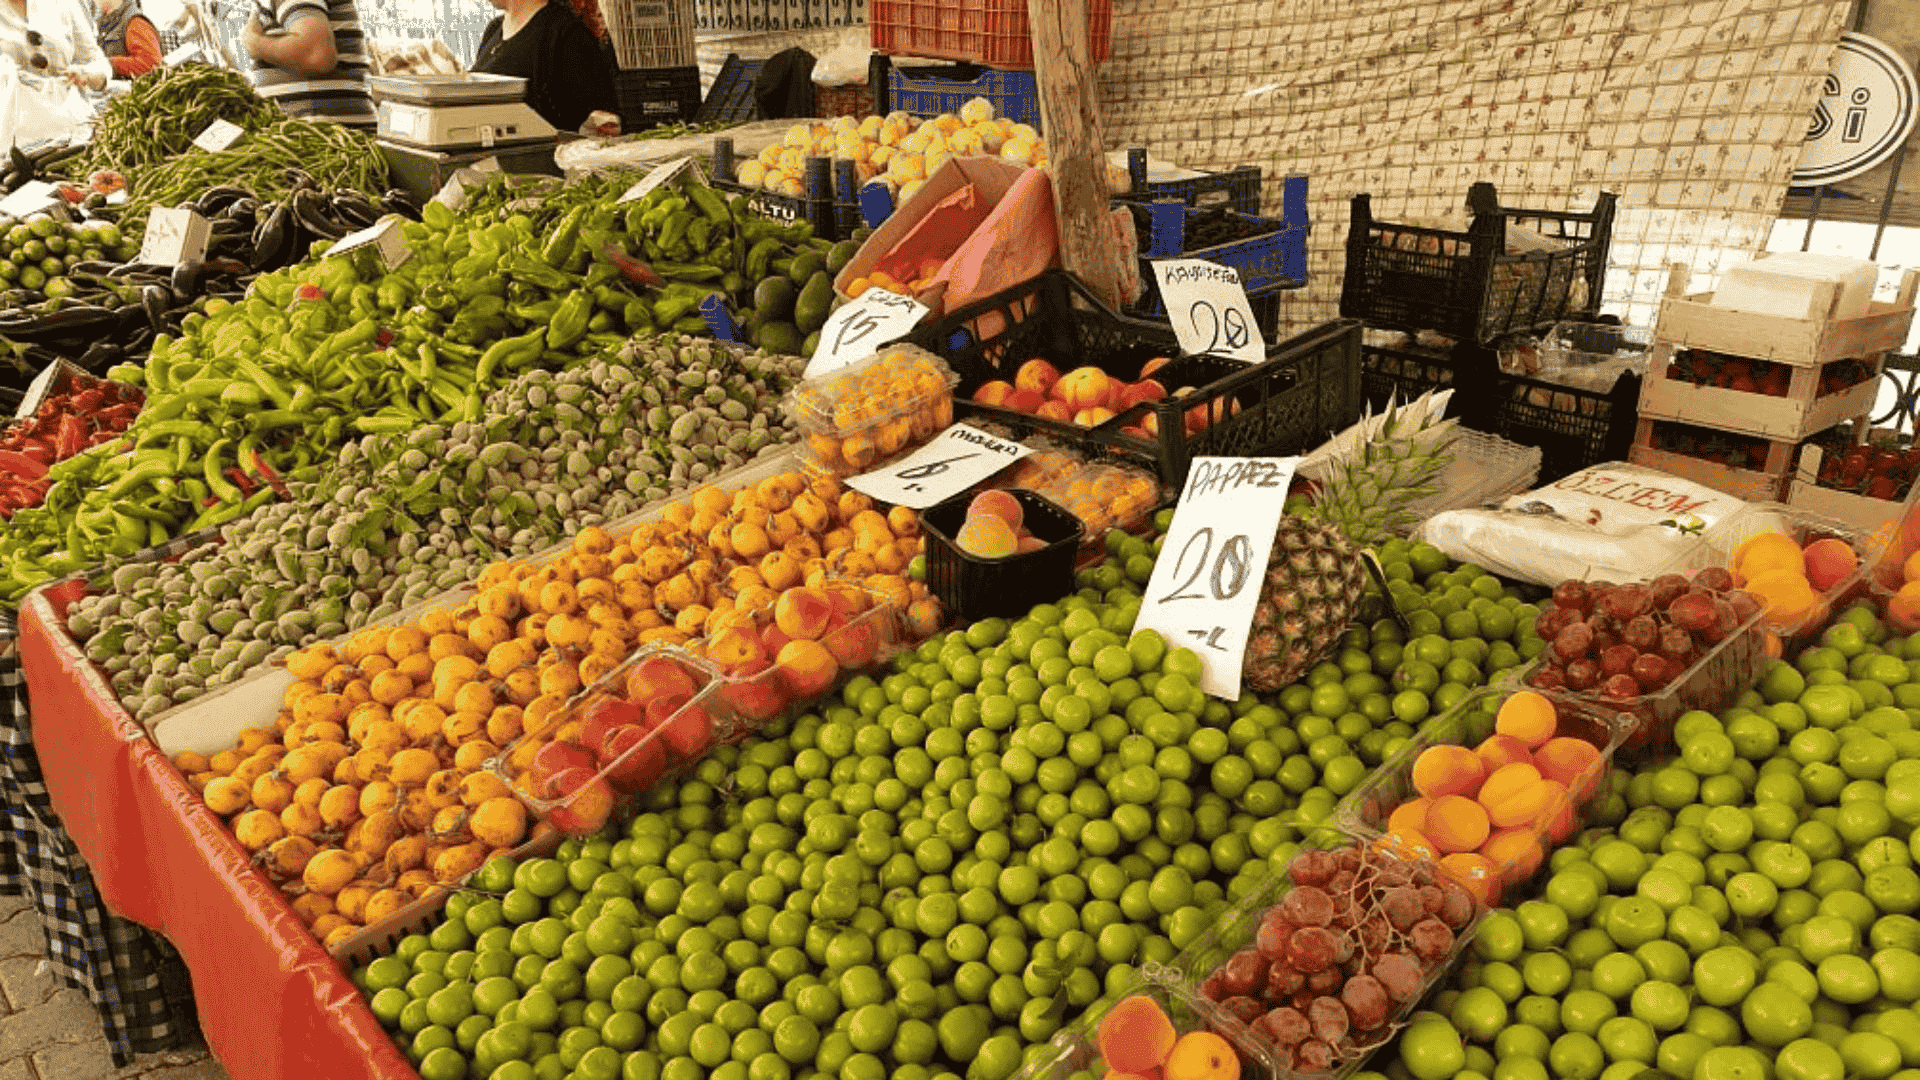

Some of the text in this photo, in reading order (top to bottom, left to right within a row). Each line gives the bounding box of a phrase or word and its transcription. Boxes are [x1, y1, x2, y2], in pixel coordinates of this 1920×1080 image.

[831, 308, 890, 356] 15
[1190, 300, 1249, 354] 20
[1157, 526, 1254, 605] 20
